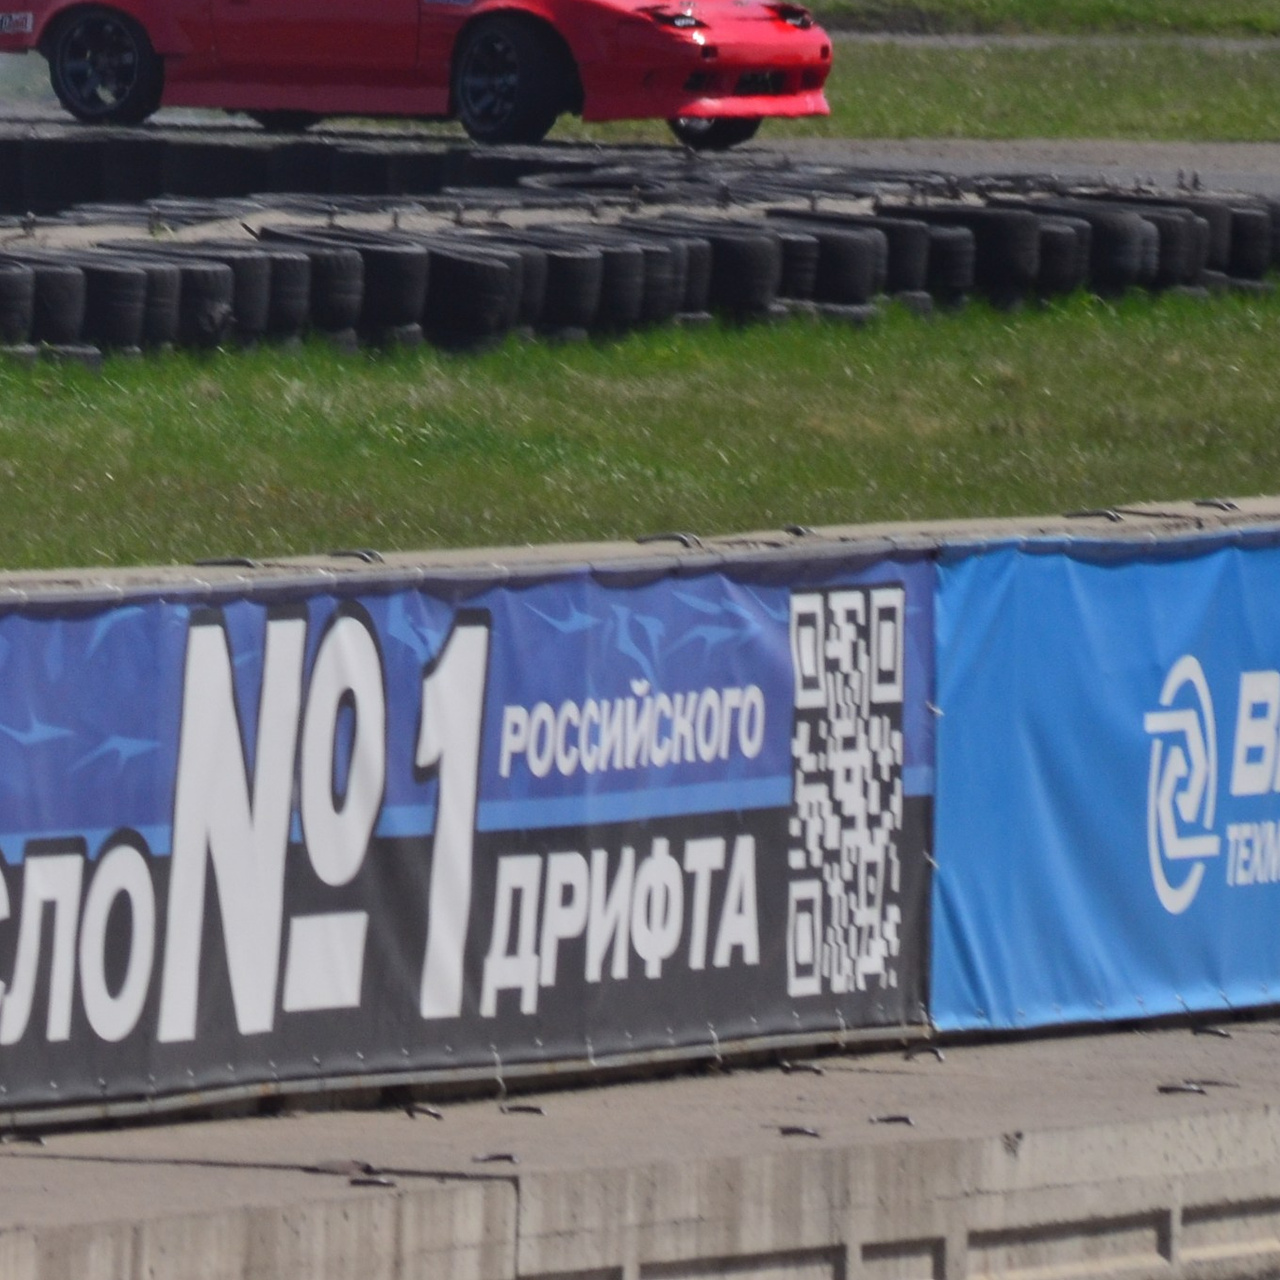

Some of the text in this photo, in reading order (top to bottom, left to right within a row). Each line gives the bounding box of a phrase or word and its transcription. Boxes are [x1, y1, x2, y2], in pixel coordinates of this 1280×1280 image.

[500, 679, 765, 779] РОССИЙСКОГО
[1230, 670, 1280, 797] В
[480, 834, 761, 1018] ДРИФТА
